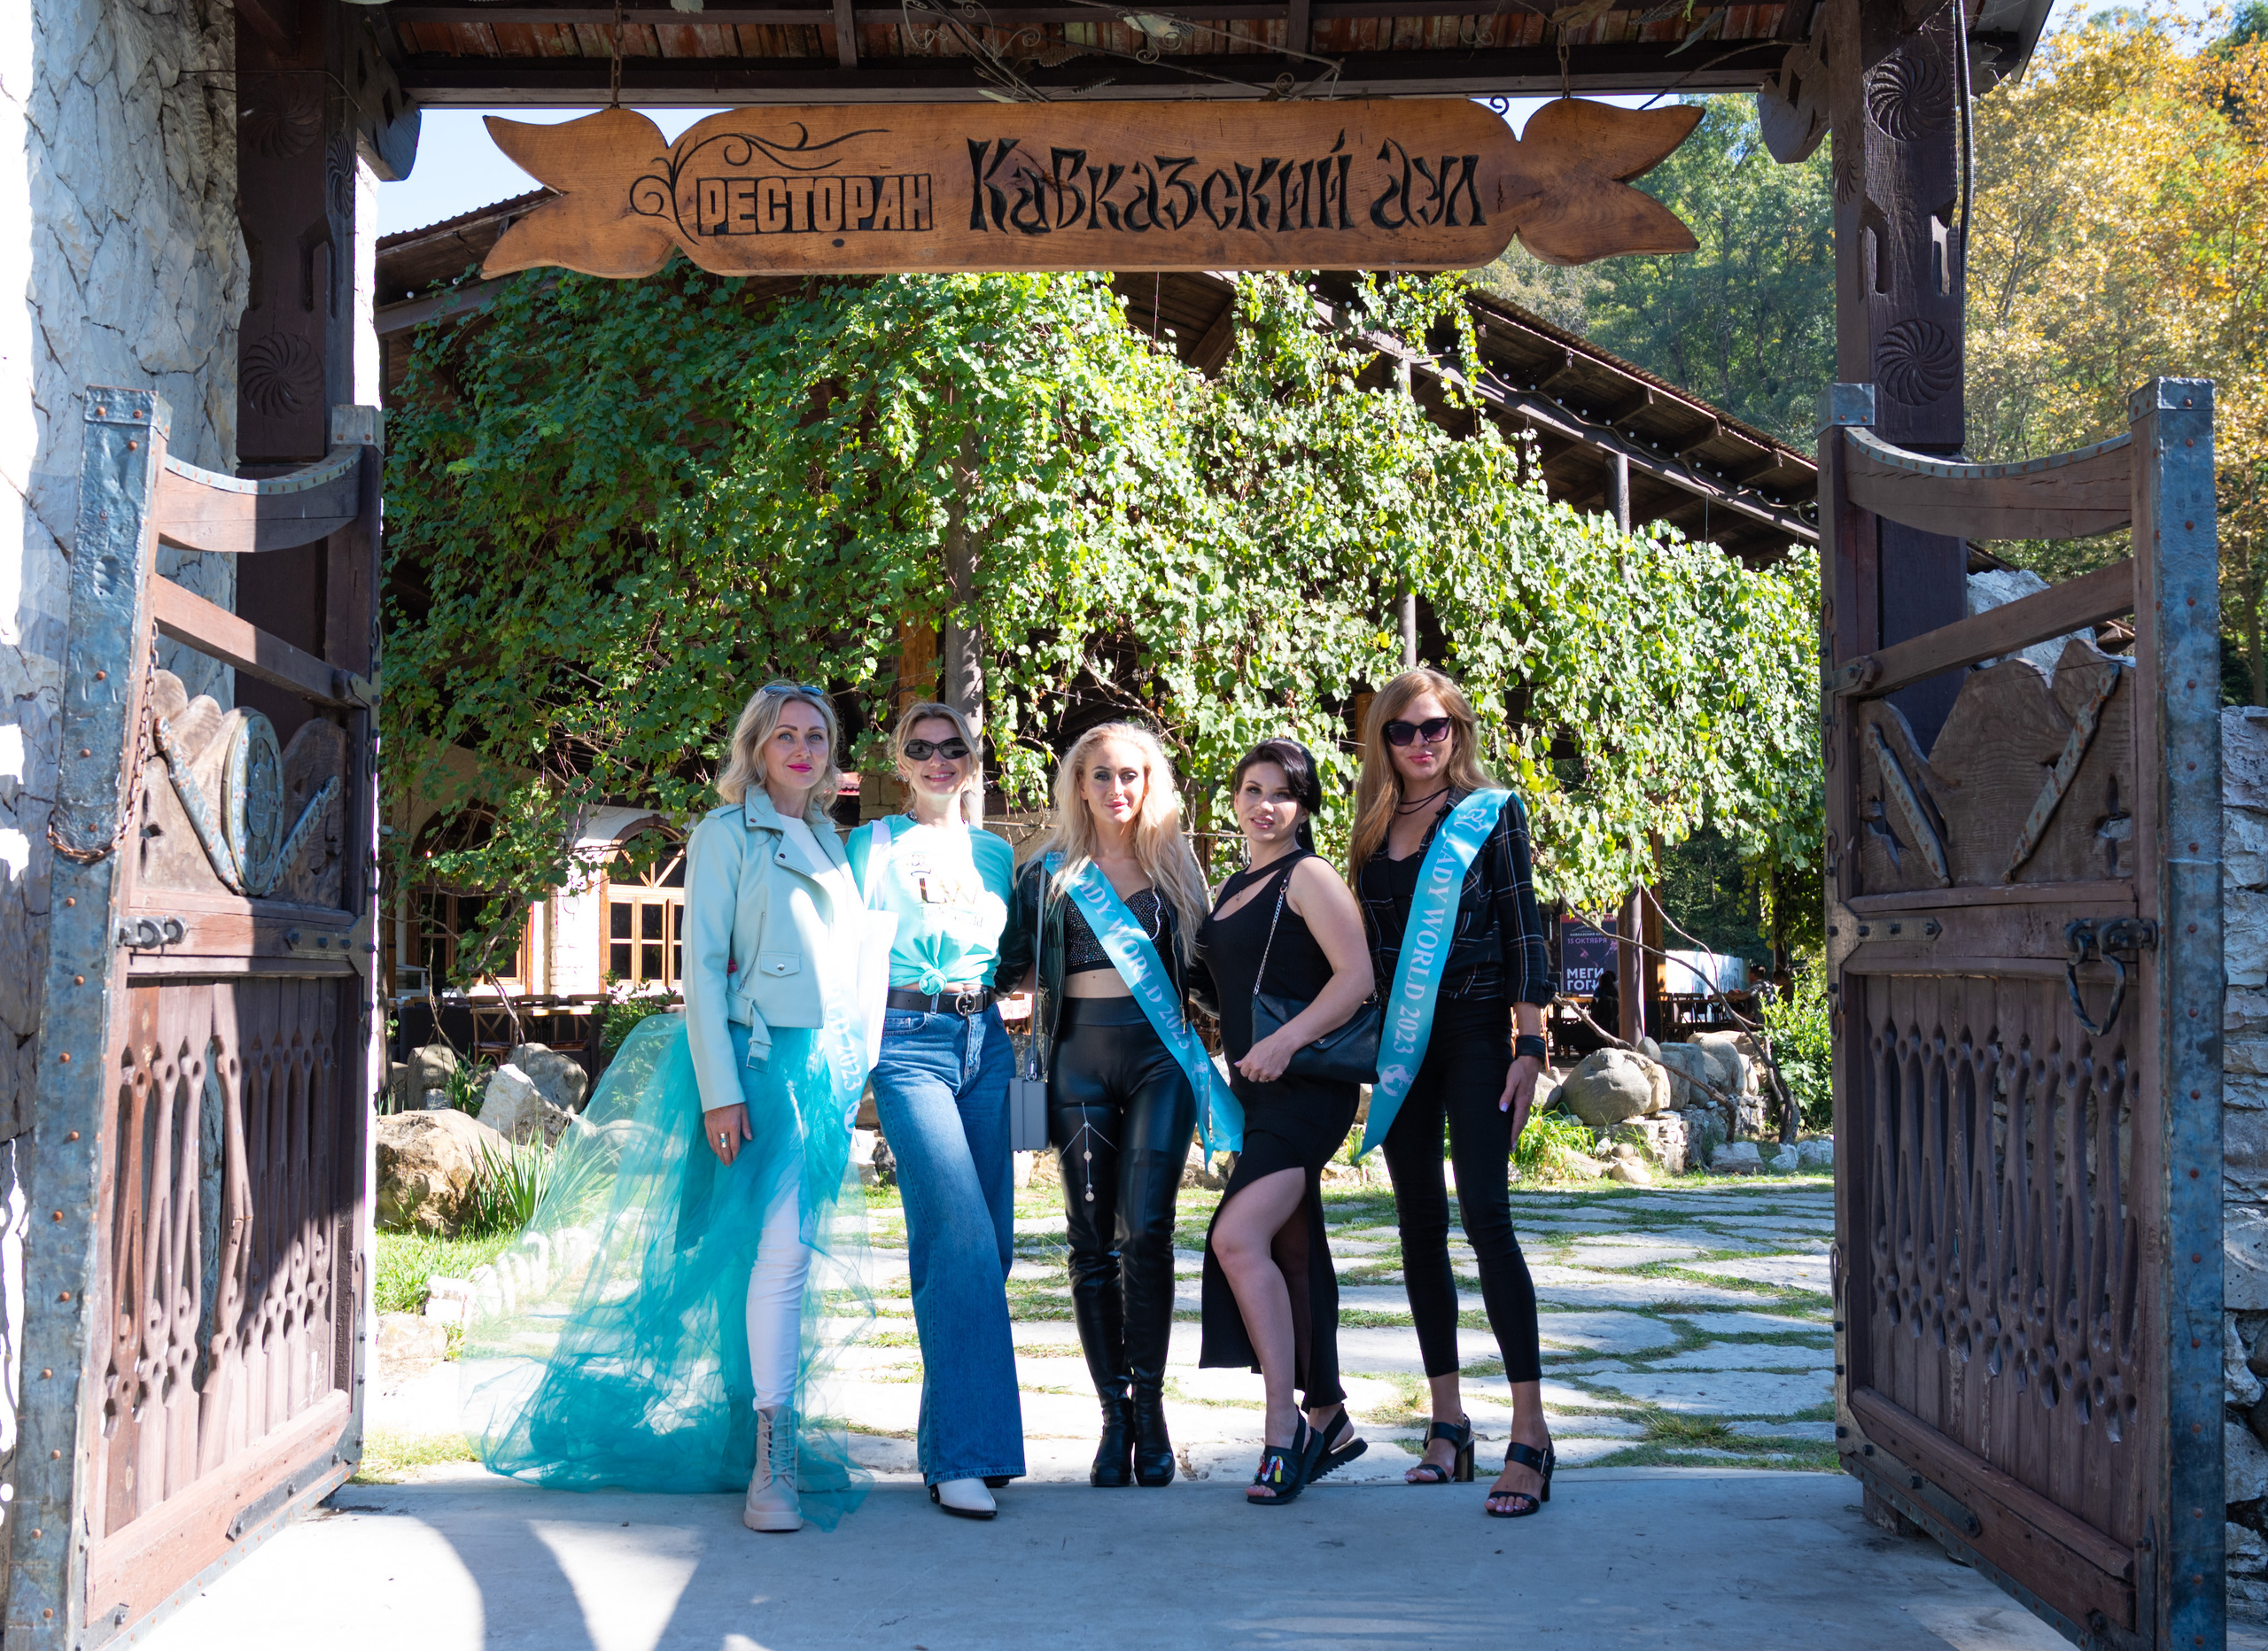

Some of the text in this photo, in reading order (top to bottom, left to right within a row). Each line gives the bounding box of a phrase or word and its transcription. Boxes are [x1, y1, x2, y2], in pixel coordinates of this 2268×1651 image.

[697, 174, 932, 236] РЕСТОРАН
[1077, 872, 1116, 916] ADY
[1107, 917, 1163, 1003] WORLD
[1393, 837, 1465, 1054] LADY WORLD 2023
[1567, 967, 1604, 979] МЕГИ
[835, 1039, 863, 1091] 2023
